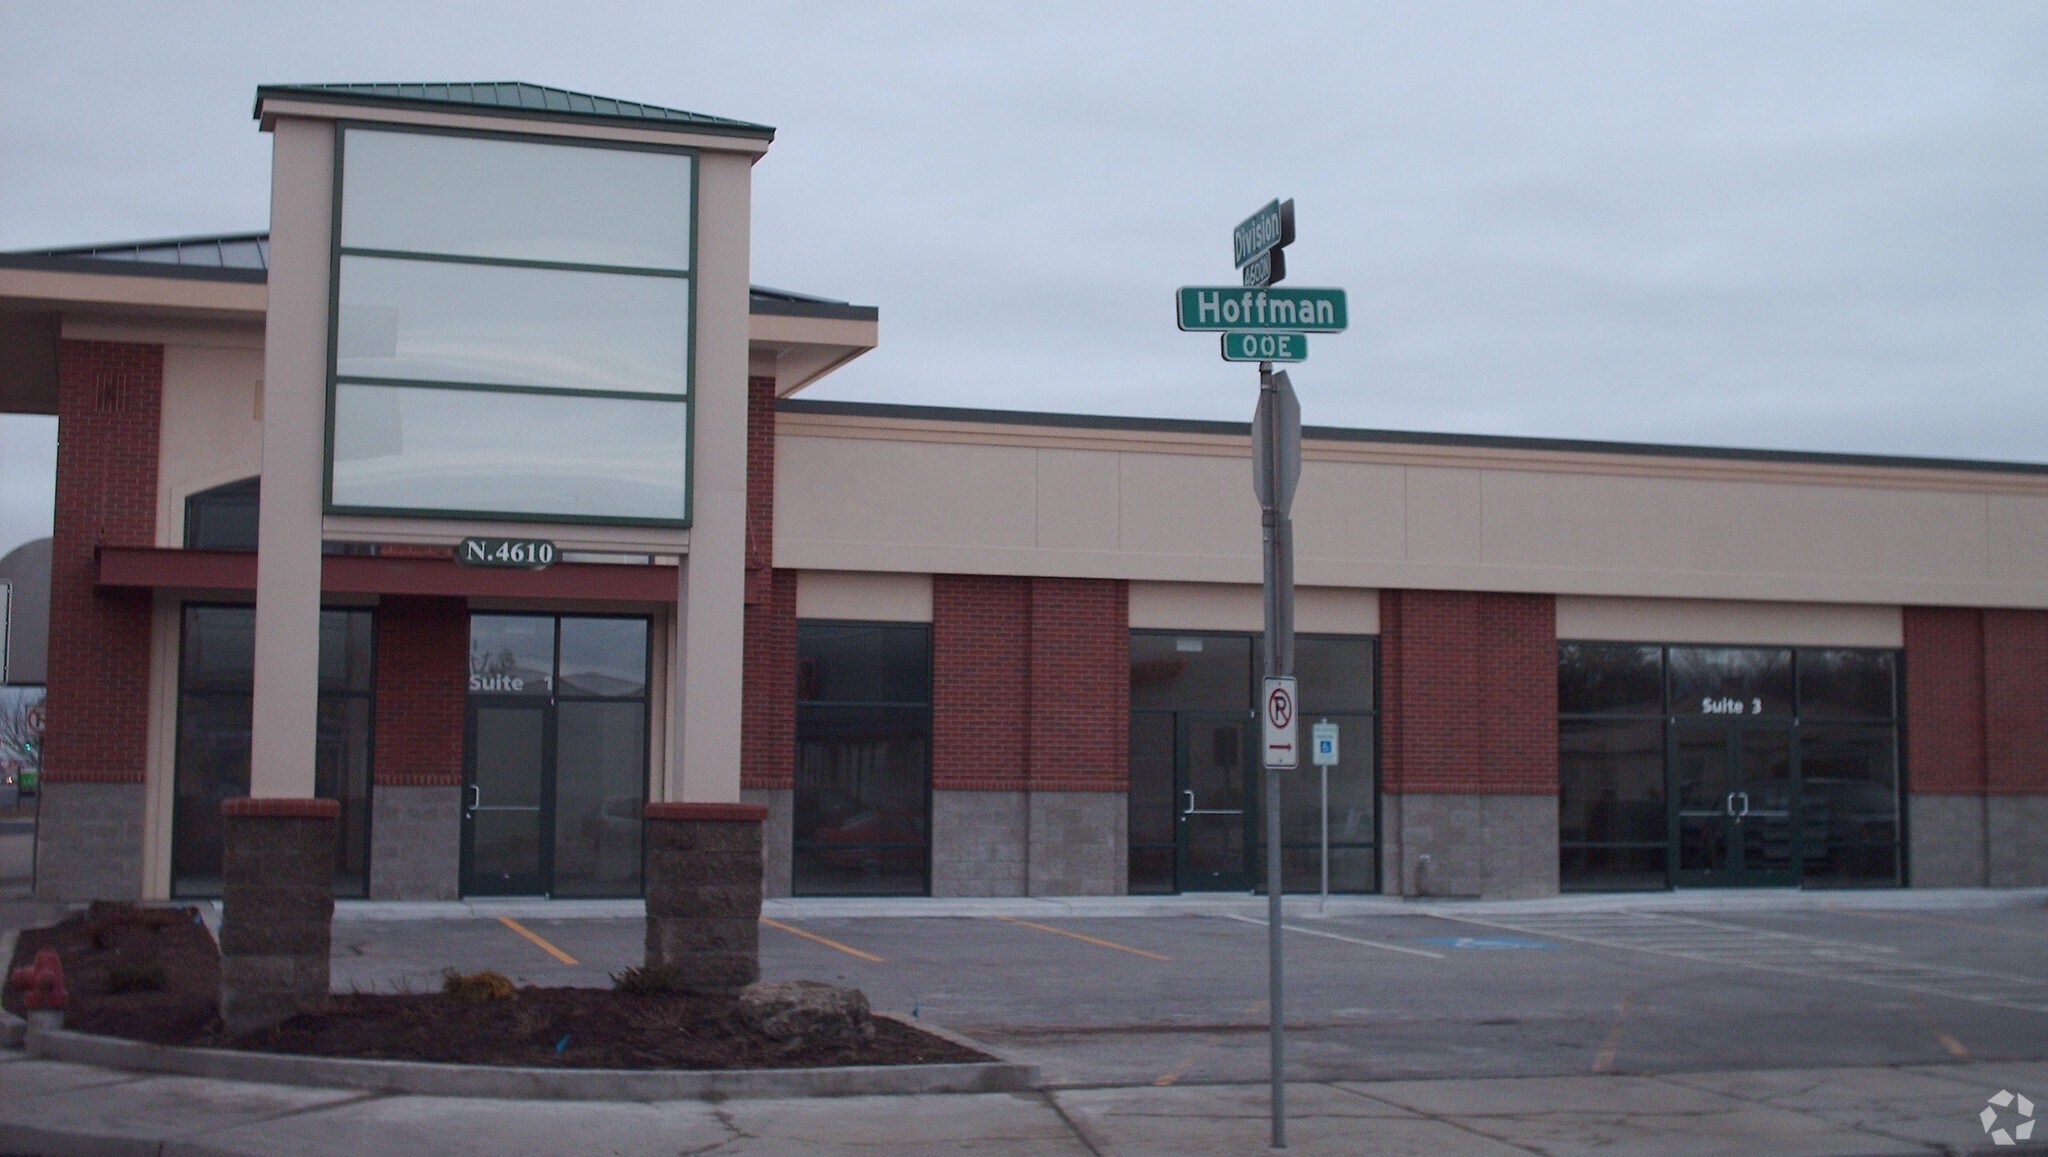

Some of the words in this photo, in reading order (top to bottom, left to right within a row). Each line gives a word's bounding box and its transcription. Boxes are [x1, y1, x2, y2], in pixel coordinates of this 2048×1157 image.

[1235, 212, 1280, 263] Division
[1198, 291, 1334, 324] Hoffman
[466, 540, 553, 563] N.4610
[469, 674, 523, 691] Suite
[544, 675, 553, 691] 1
[1702, 697, 1744, 714] Suite
[1751, 697, 1762, 714] 3
